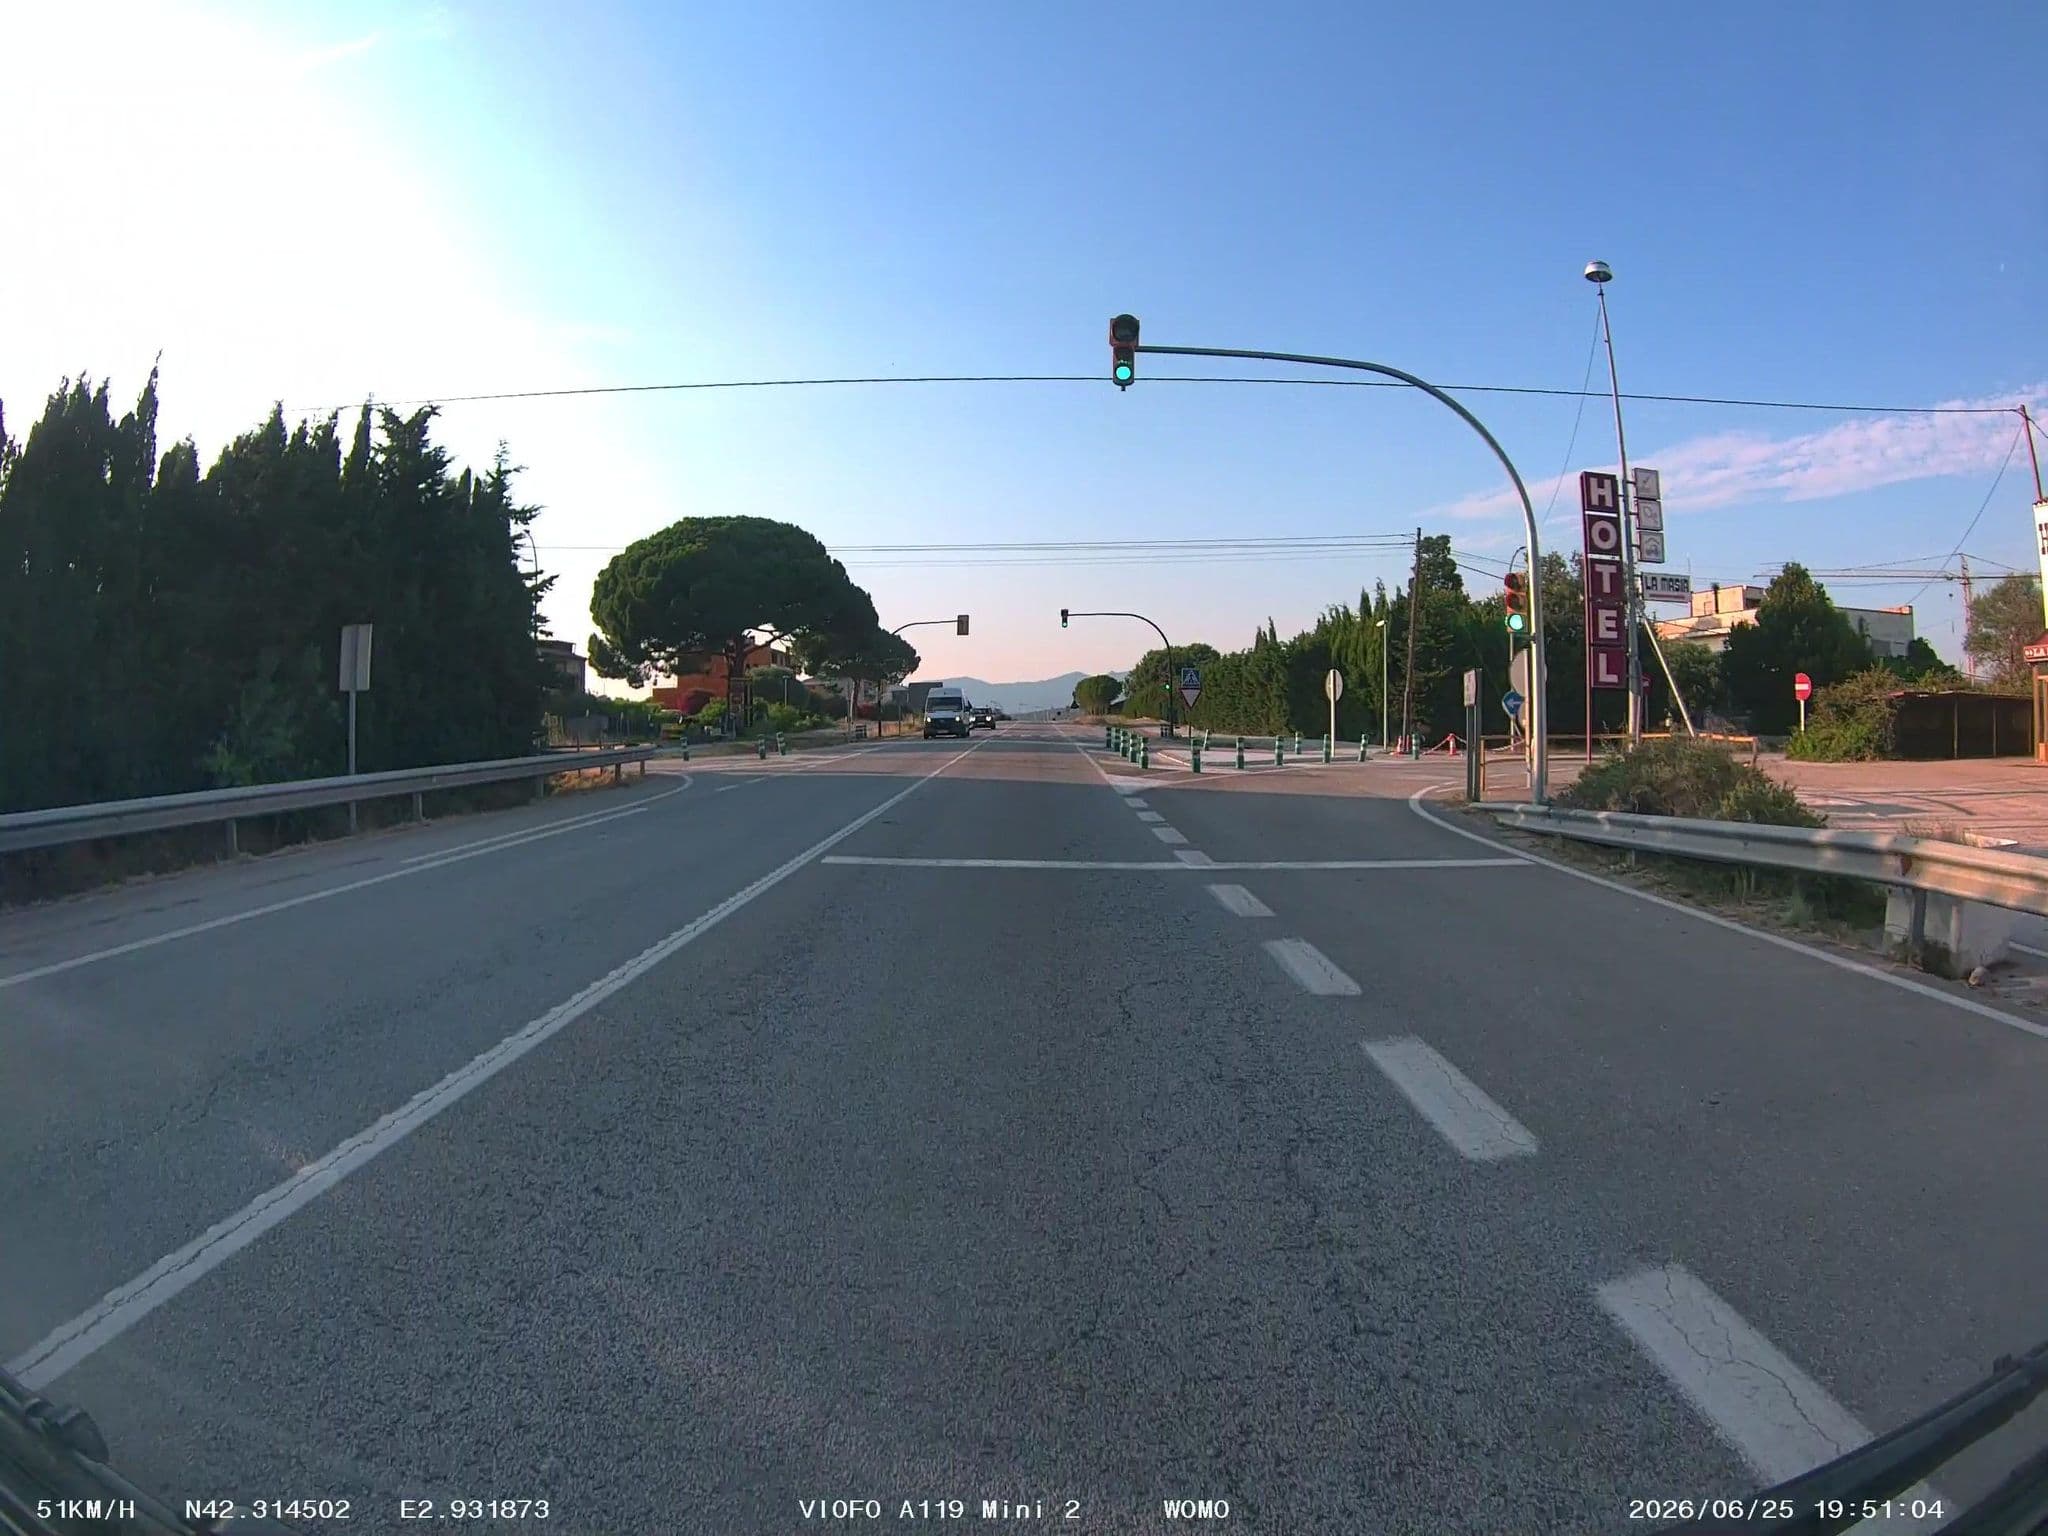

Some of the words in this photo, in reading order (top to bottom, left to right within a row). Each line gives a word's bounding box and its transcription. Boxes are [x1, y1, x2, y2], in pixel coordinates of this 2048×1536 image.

[1589, 477, 1618, 684] HOTEL
[1645, 575, 1657, 591] LA
[1661, 576, 1689, 593] MASIA
